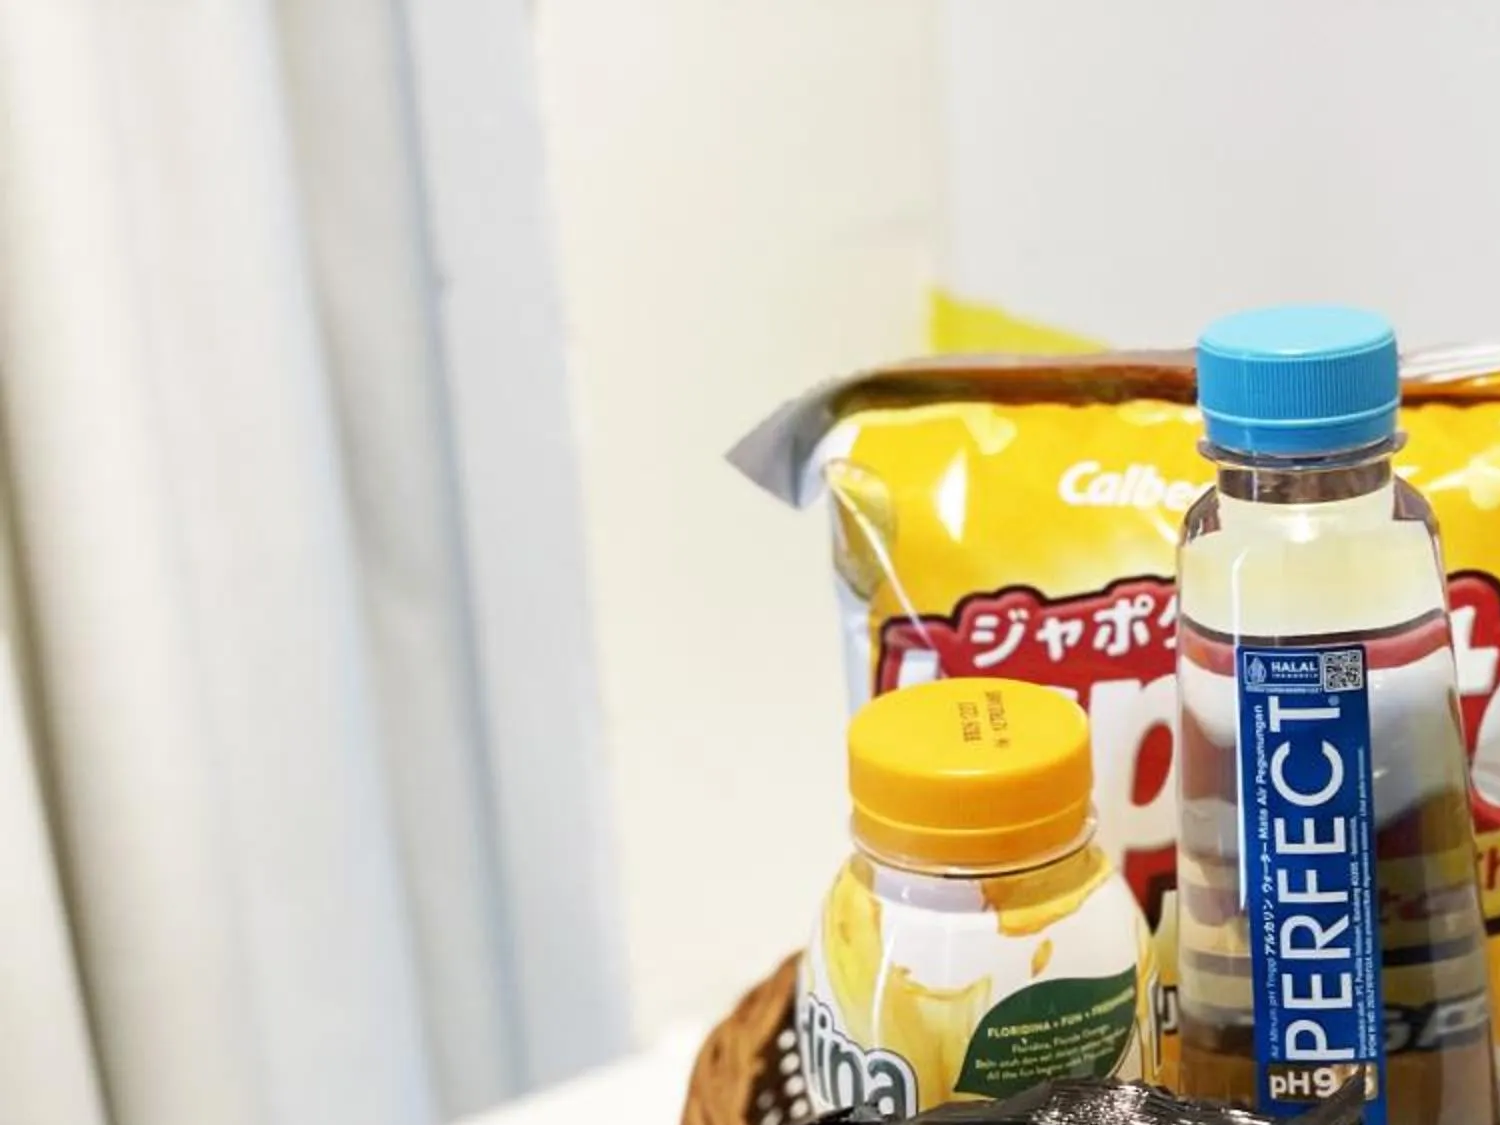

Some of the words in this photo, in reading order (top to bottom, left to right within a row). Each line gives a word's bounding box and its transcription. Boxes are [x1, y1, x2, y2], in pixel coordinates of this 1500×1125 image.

[1058, 460, 1217, 512] Calbe
[1271, 661, 1318, 672] HALAL
[1255, 705, 1268, 783] Pegunungan
[1256, 785, 1268, 805] Air
[1267, 695, 1355, 1060] PERFECT
[987, 1021, 1051, 1037] FLORIDINA
